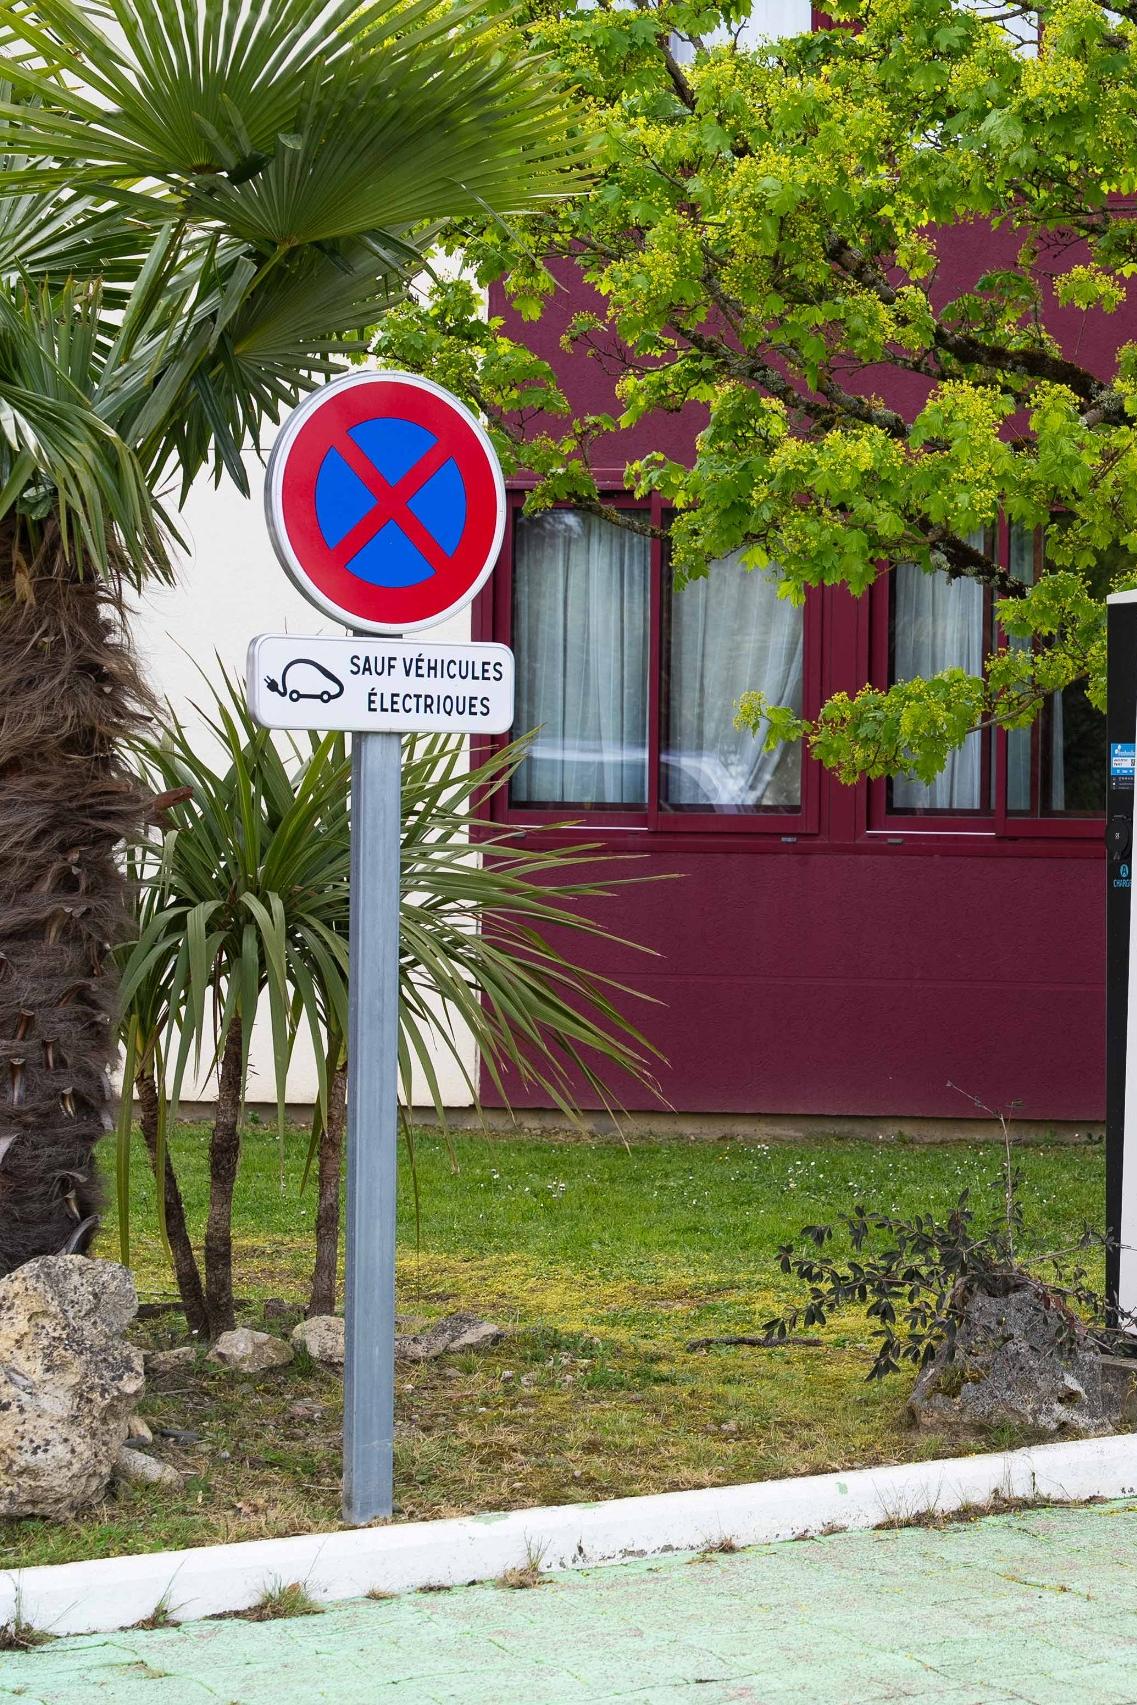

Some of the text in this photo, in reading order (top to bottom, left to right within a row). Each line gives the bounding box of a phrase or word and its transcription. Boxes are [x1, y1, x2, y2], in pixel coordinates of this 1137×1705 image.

[350, 653, 503, 681] SAUF VÉHICULES
[367, 687, 490, 716] ÉLECTRIQUES
